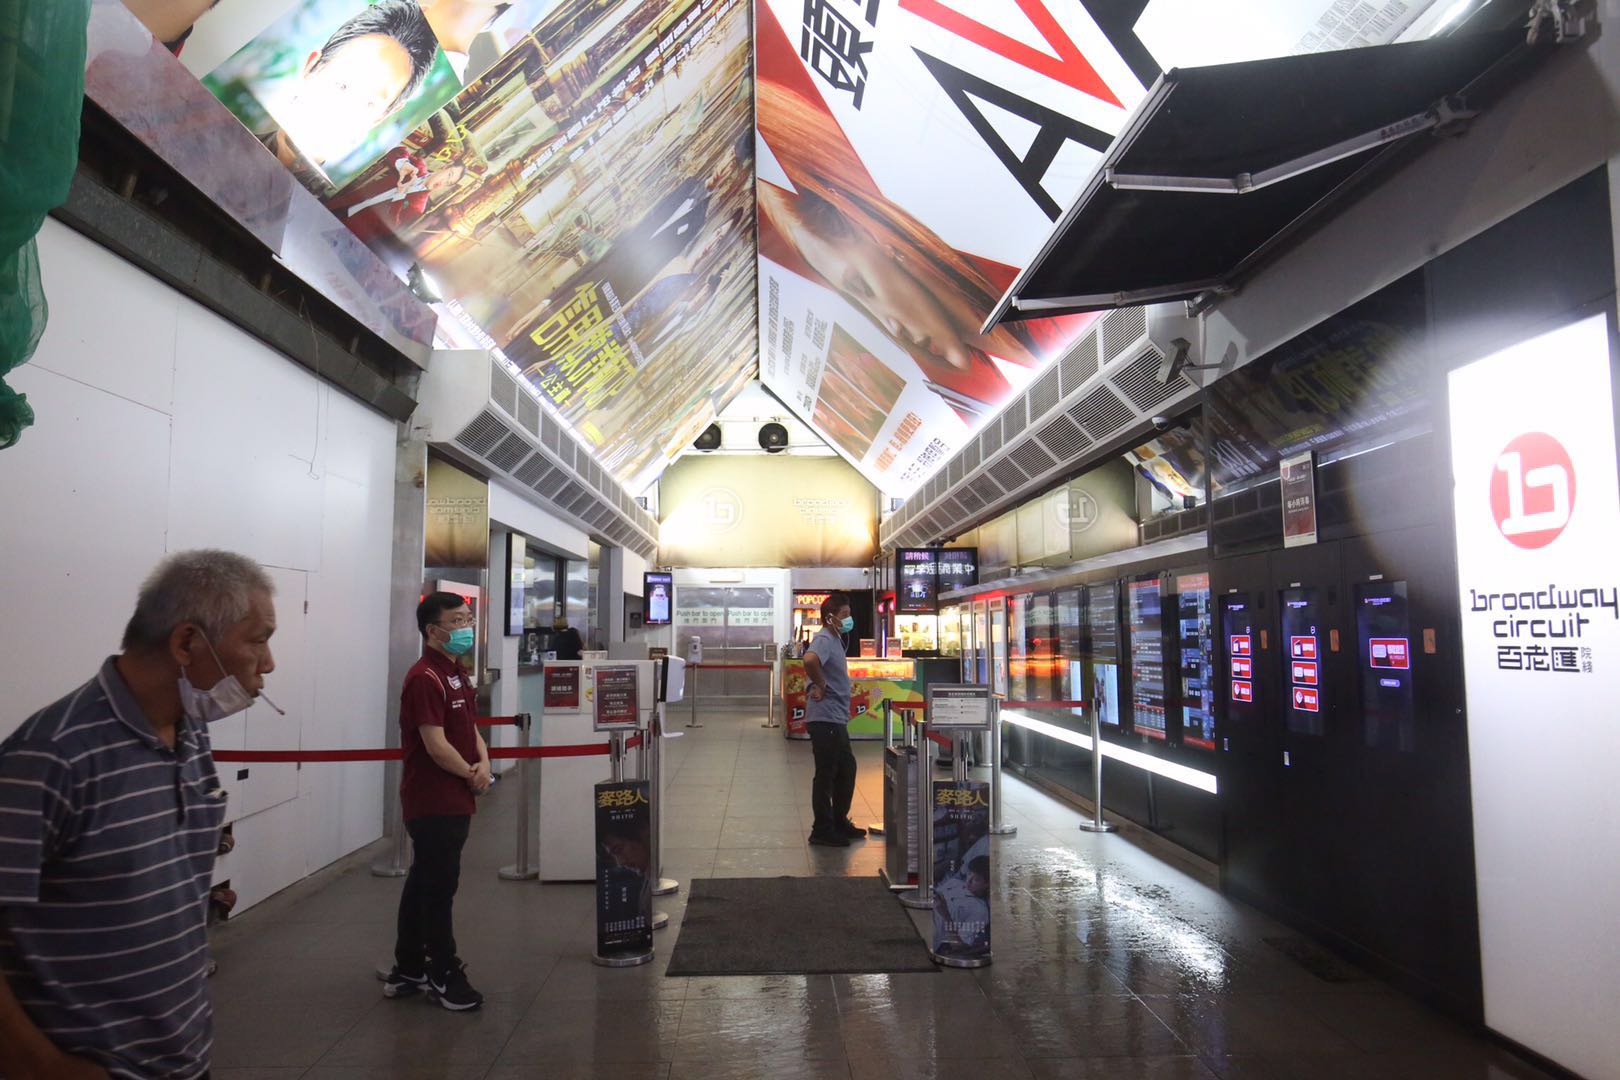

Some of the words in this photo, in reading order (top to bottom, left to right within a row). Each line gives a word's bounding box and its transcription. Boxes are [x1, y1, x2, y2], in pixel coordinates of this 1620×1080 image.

[1470, 584, 1619, 620] broadway
[1493, 612, 1590, 638] circuit
[1497, 644, 1580, 673] 百老匯
[598, 788, 648, 808] 麥路人
[936, 789, 988, 807] 麥路人
